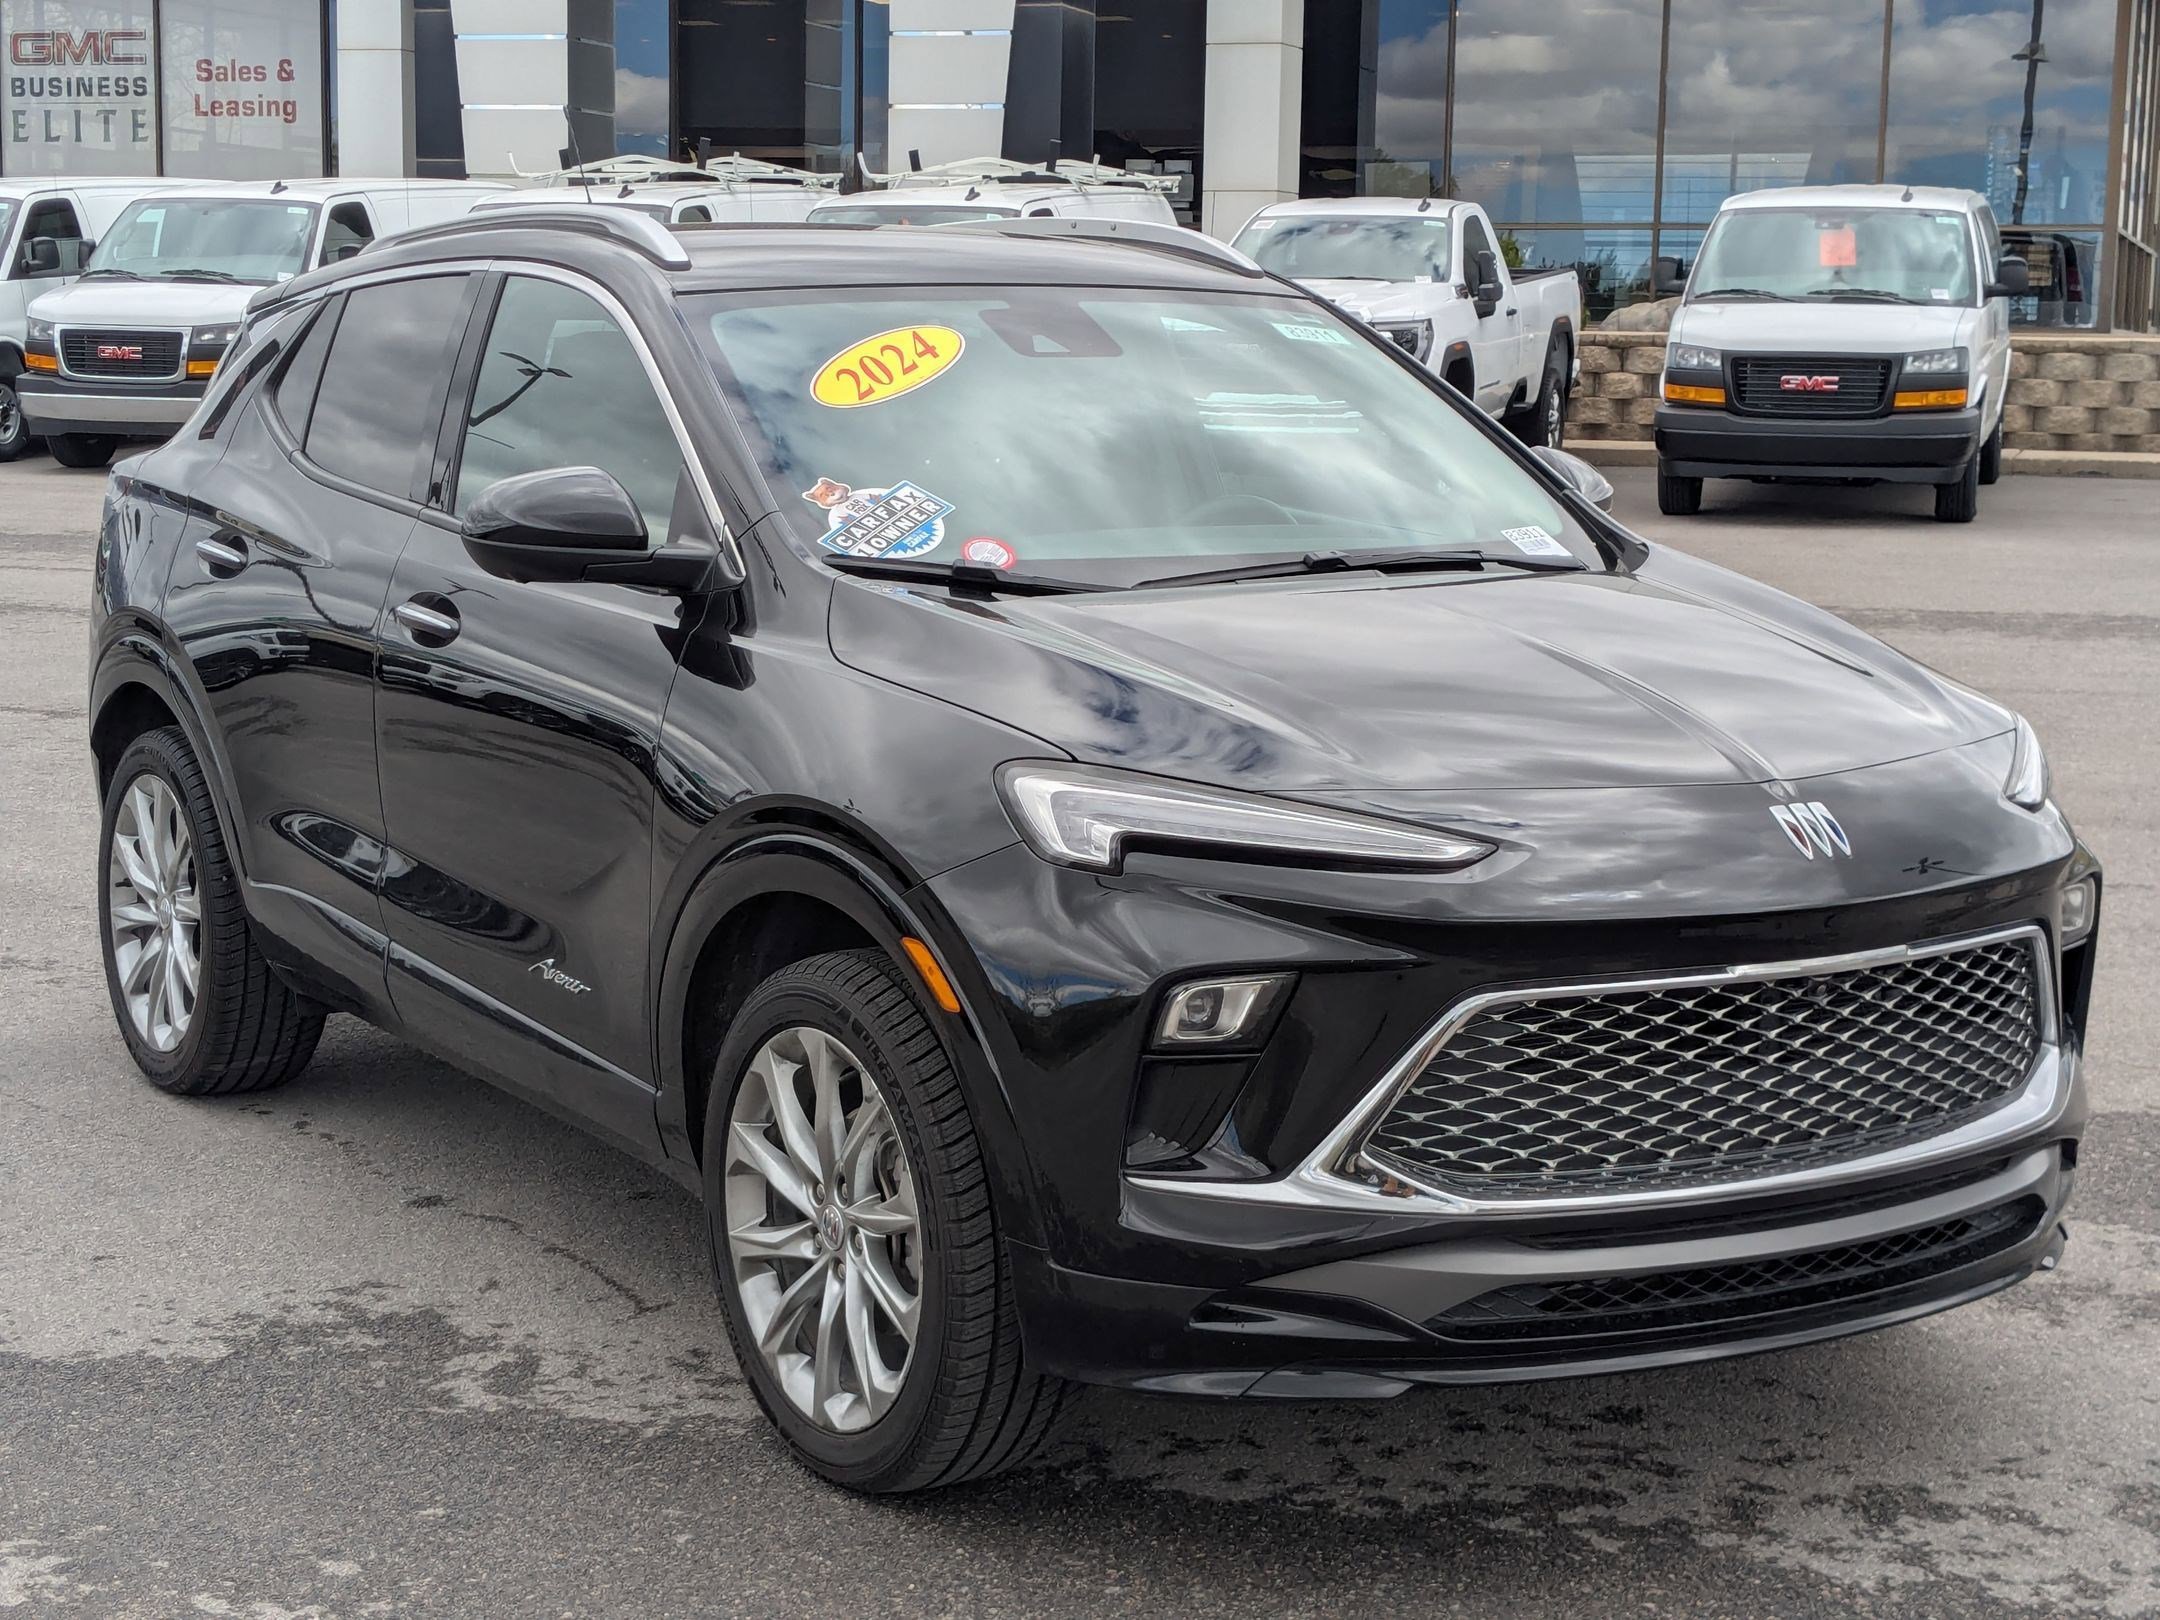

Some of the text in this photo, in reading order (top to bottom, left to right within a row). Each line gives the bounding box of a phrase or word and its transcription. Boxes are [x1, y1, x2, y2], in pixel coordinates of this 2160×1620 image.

[10, 29, 147, 66] GMC
[195, 58, 296, 83] Sales &
[10, 76, 148, 98] BUSINESS
[194, 94, 297, 124] Leasing
[12, 108, 149, 143] ELITE
[97, 345, 143, 360] GMC
[836, 330, 940, 401] 2024
[1779, 375, 1840, 392] GMC
[835, 490, 921, 548] CARFAX
[857, 547, 876, 557] 1
[870, 500, 942, 549] OWNER
